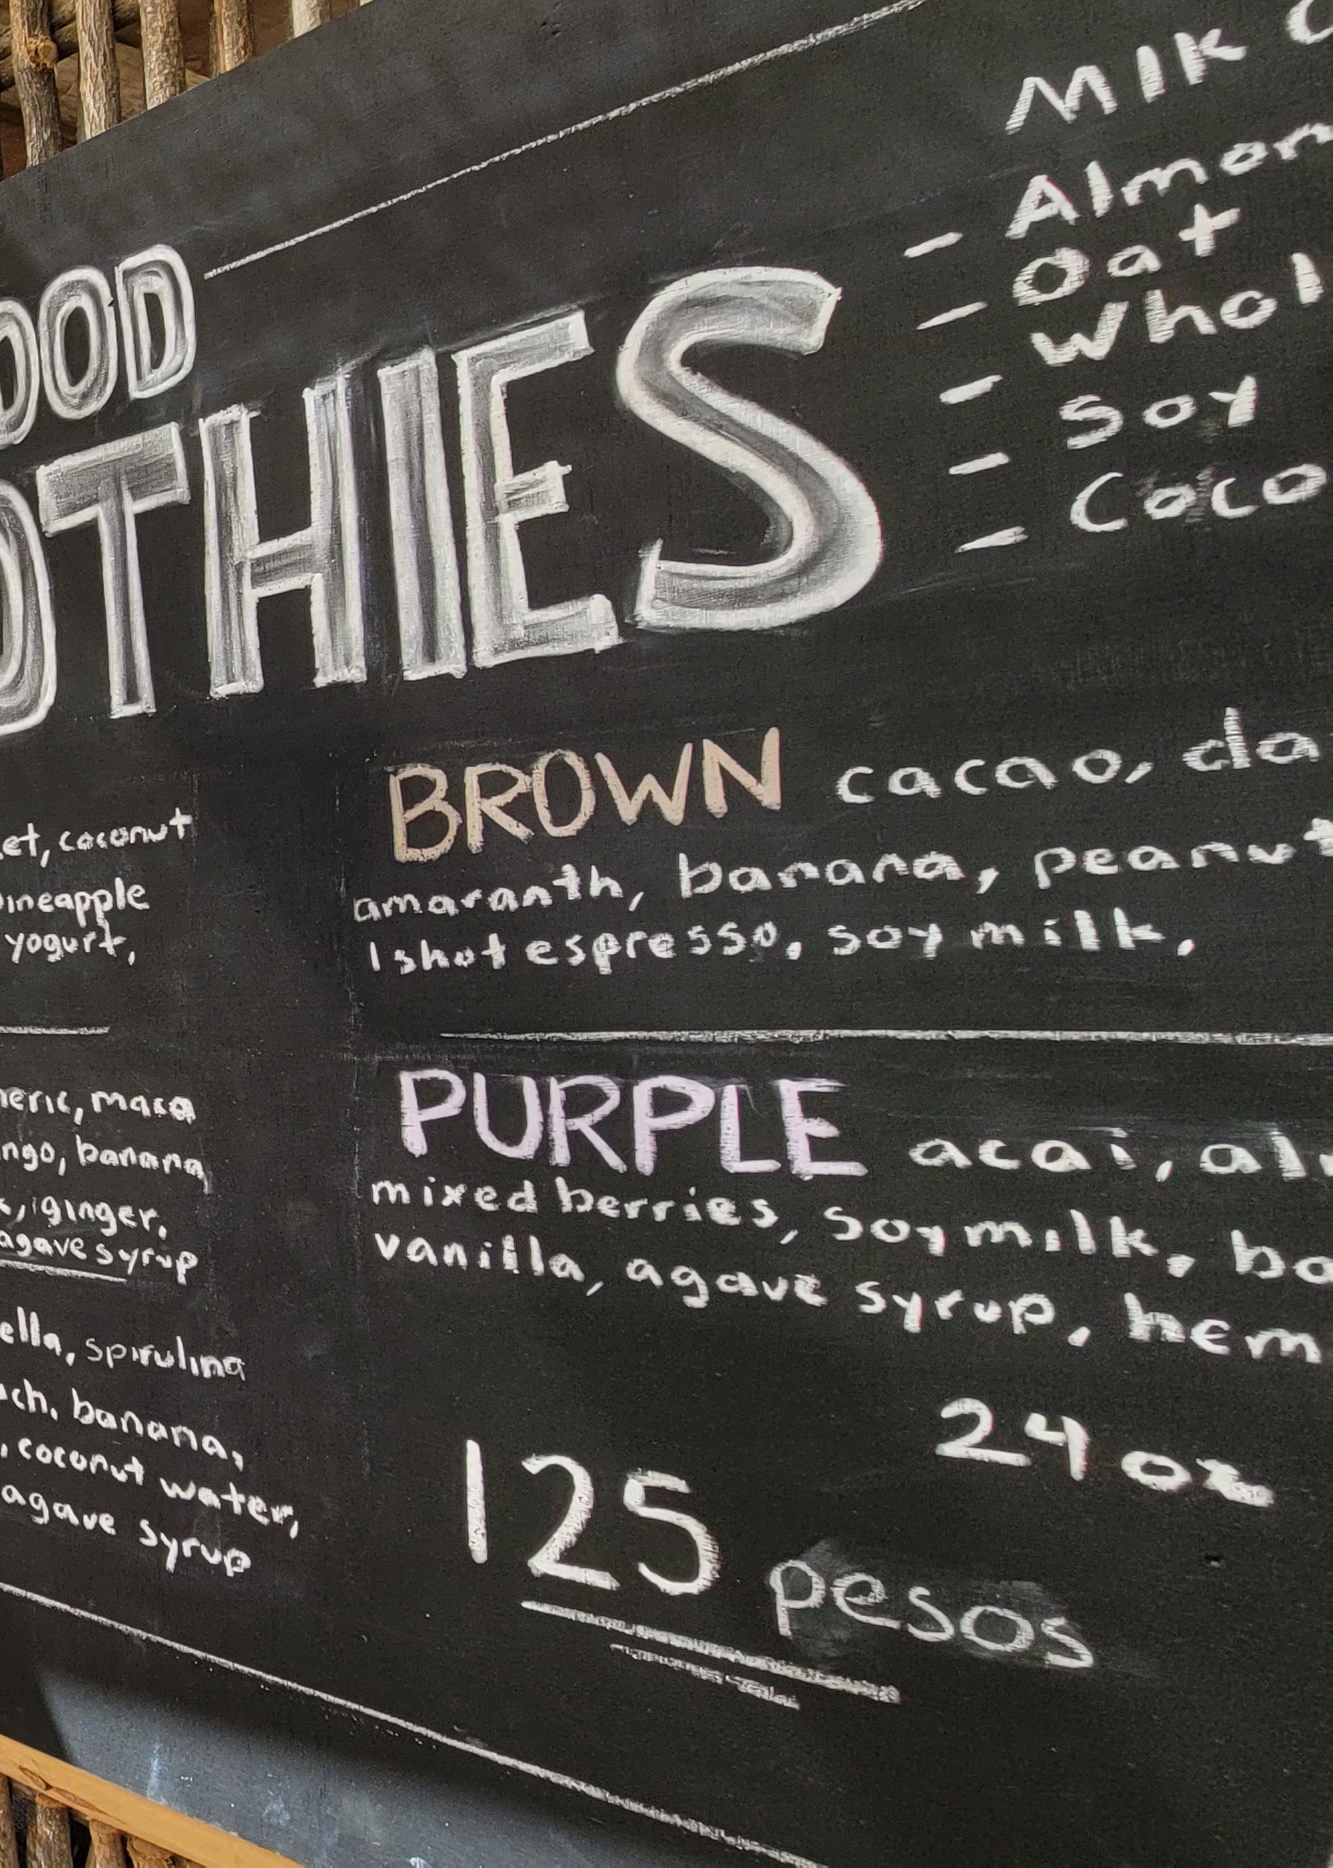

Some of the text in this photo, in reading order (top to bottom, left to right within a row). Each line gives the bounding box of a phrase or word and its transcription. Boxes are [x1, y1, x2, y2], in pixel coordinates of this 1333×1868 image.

[1012, 203, 1241, 306] Oat
[59, 807, 192, 850] coconut
[389, 727, 780, 862] BROWN
[835, 749, 1154, 803] cacao,
[352, 863, 645, 923] amaranth,
[678, 852, 1000, 898] banana,
[5, 925, 135, 965] yogurt,
[91, 1091, 196, 1124] maca
[398, 1068, 869, 1180] PURPLE
[41, 1195, 168, 1240] ginger,
[371, 1177, 538, 1214] mixed
[555, 1176, 799, 1244] berries,
[96, 1243, 198, 1286] syrup
[373, 1233, 604, 1296] vanilla,
[626, 1258, 827, 1309] agave
[1124, 1291, 1322, 1363] hem
[86, 1336, 246, 1381] spirulina
[72, 1388, 244, 1472] banana,
[936, 1398, 1087, 1480] 24
[18, 1436, 145, 1487] coconut
[160, 1477, 299, 1538] water,
[1, 1484, 117, 1536] agave
[139, 1518, 251, 1575] syrup
[466, 1439, 1096, 1669] 125 pesos
